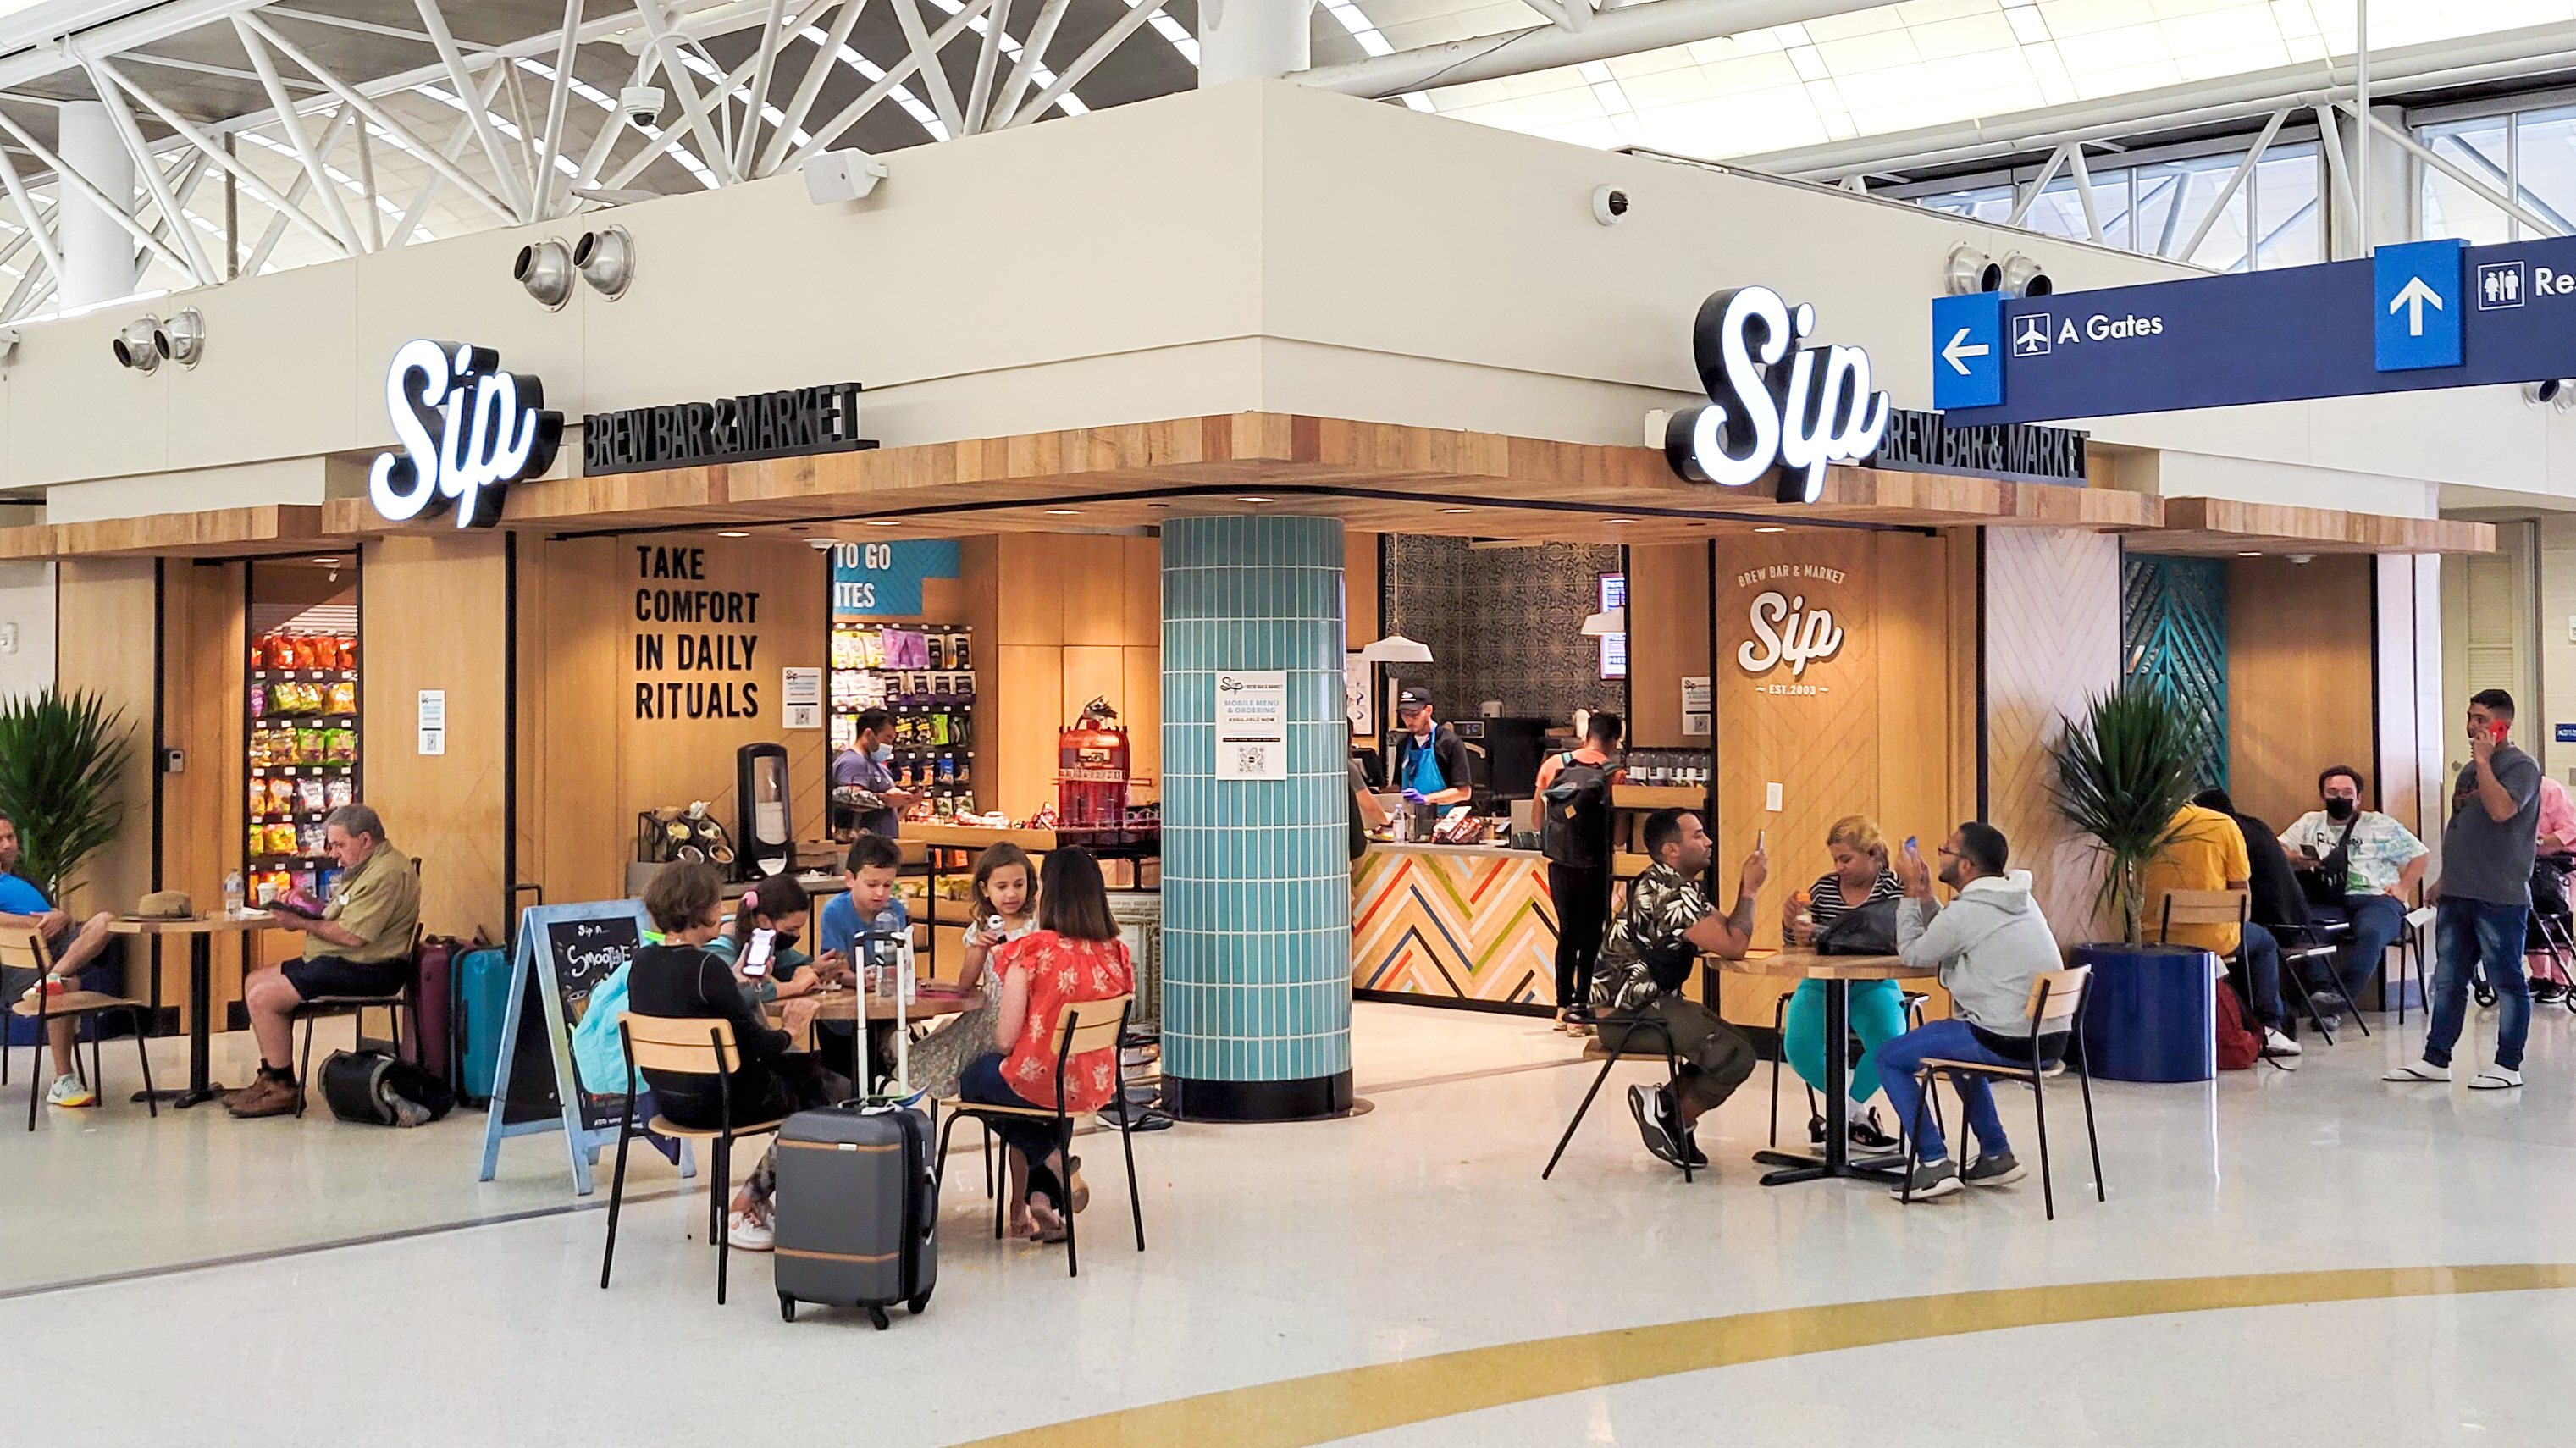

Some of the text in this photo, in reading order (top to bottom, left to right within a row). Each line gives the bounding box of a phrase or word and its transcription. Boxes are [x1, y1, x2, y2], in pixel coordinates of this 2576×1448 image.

[2535, 268, 2576, 296] Re
[2057, 314, 2164, 345] A Gates
[1694, 285, 1890, 504] Sip
[369, 339, 536, 529] Sip
[584, 383, 855, 468] BREW BAR & MARKET
[1943, 425, 1985, 471] BAR
[1988, 424, 2004, 472] &
[2007, 422, 2091, 479] MARKET
[636, 546, 705, 580] TAKE
[834, 543, 891, 570] TO GO
[1738, 564, 1846, 588] BREW BAR & MARKET
[636, 589, 760, 623] COMFORT
[636, 633, 757, 671] IN DAILY
[1738, 592, 1844, 676] Sip
[636, 683, 759, 719] RITUALS
